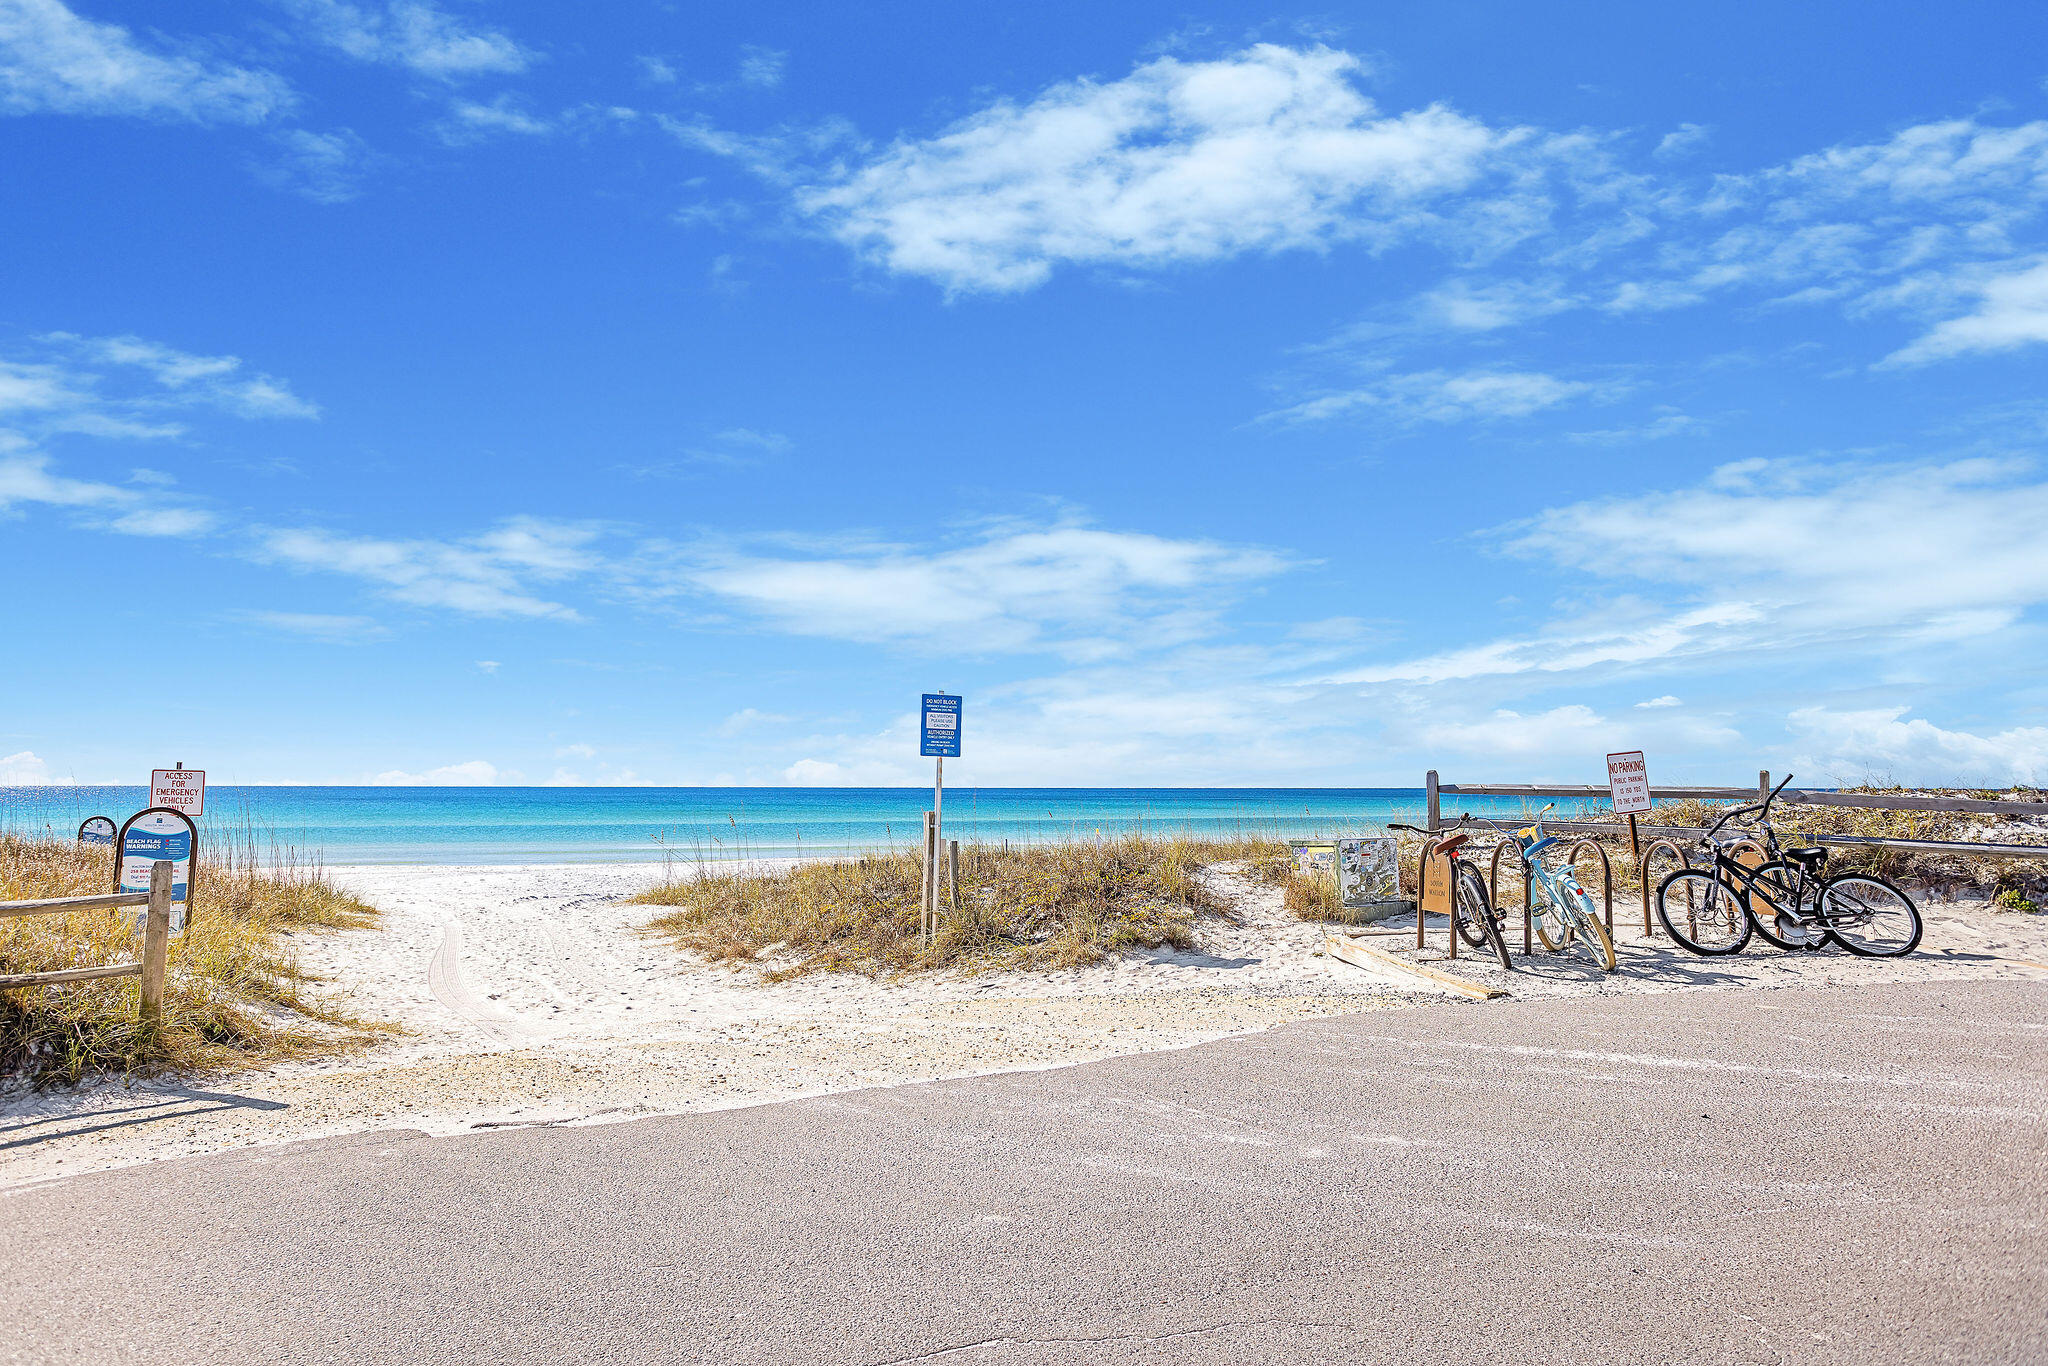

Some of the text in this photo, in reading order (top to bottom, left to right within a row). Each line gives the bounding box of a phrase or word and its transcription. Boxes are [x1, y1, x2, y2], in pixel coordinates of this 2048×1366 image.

[1609, 760, 1644, 774] NO PARKING
[164, 772, 193, 780] ACCESS
[171, 780, 186, 788] FOR
[155, 788, 200, 796] EMERGENCY
[159, 796, 194, 804] VEHICLES
